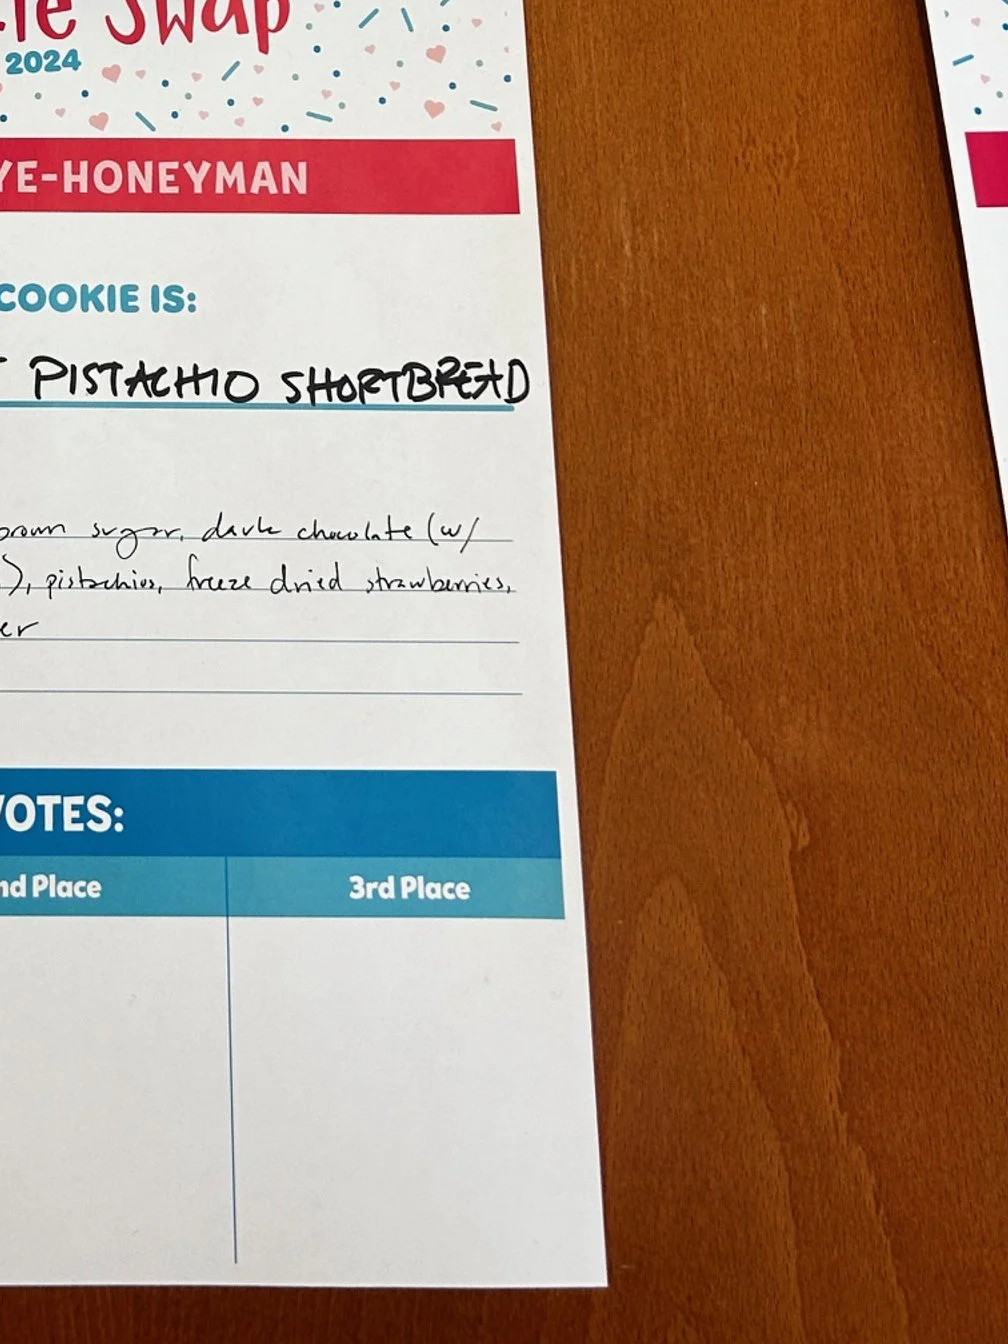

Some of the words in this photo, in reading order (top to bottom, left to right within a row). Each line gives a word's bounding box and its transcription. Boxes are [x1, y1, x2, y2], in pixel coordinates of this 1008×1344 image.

[5, 50, 81, 76] 2024
[151, 283, 196, 313] IS:
[30, 355, 259, 403] PISTACHIO
[281, 356, 530, 406] SHORTBREAD
[201, 512, 282, 542] dark
[297, 514, 412, 541] chocolate
[46, 565, 163, 599] pistachios,
[186, 553, 250, 591] freeze
[270, 561, 342, 594] dried
[366, 566, 511, 594] strawberries,
[30, 872, 102, 899] Place
[348, 874, 394, 900] 3rd
[400, 874, 471, 902] Place
